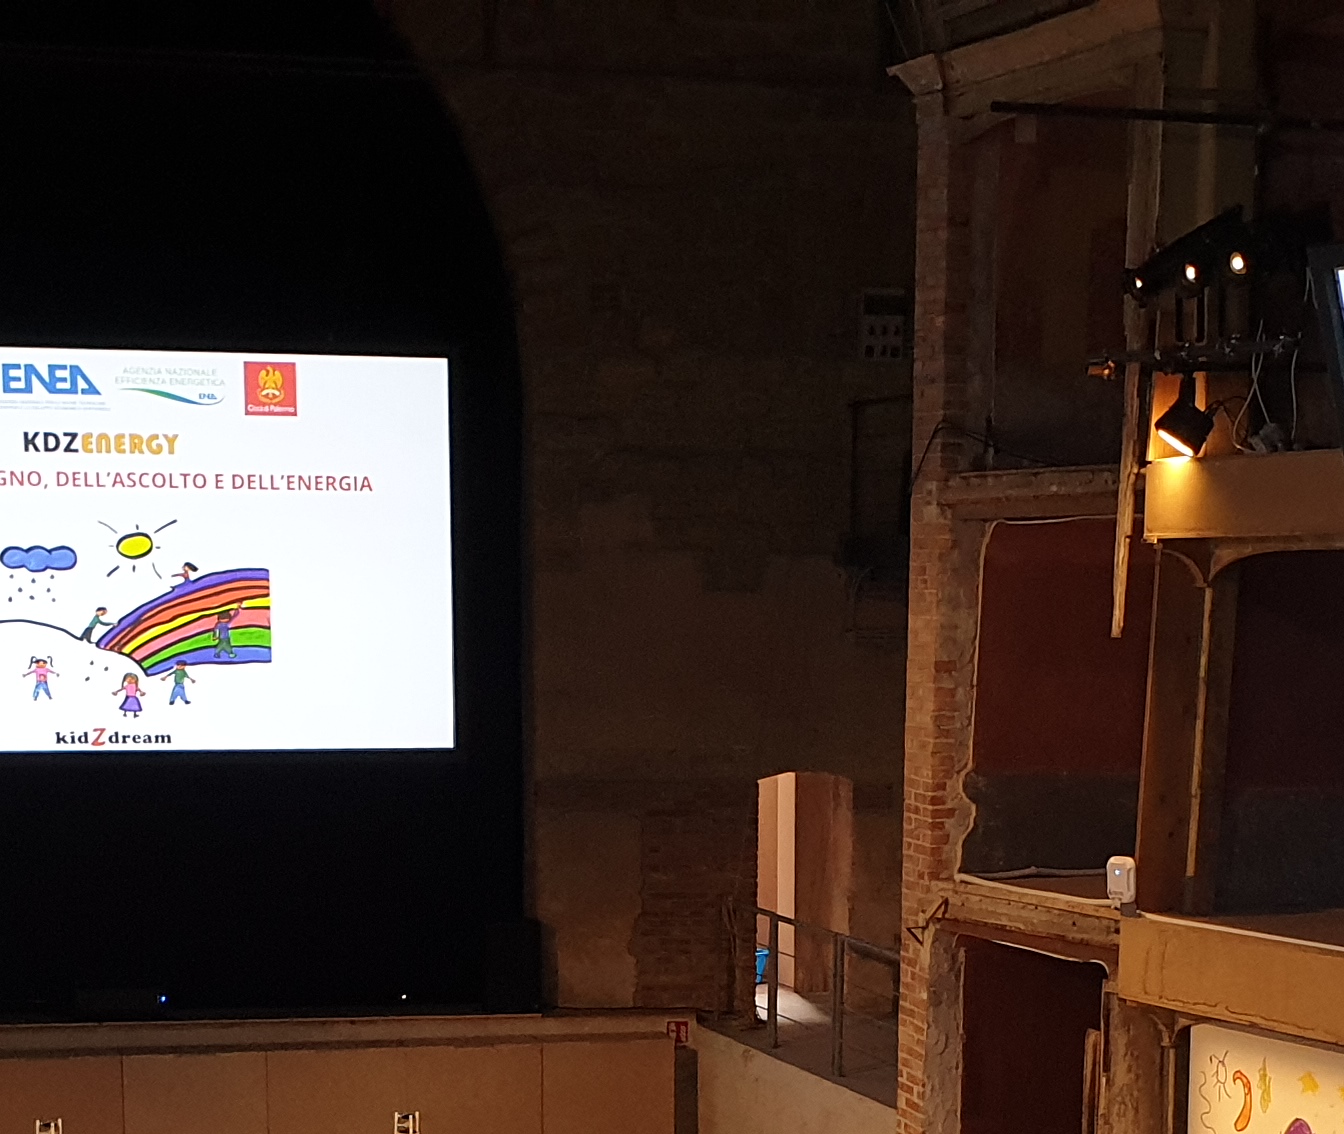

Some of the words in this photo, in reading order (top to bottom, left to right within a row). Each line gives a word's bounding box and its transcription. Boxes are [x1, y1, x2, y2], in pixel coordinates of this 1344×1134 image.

[2, 363, 102, 396] ENEA
[56, 469, 207, 490] DELL'ASCOLTO
[215, 473, 224, 490] E
[231, 473, 374, 493] DELL'ENERGIA
[55, 727, 172, 746] kidZdream
